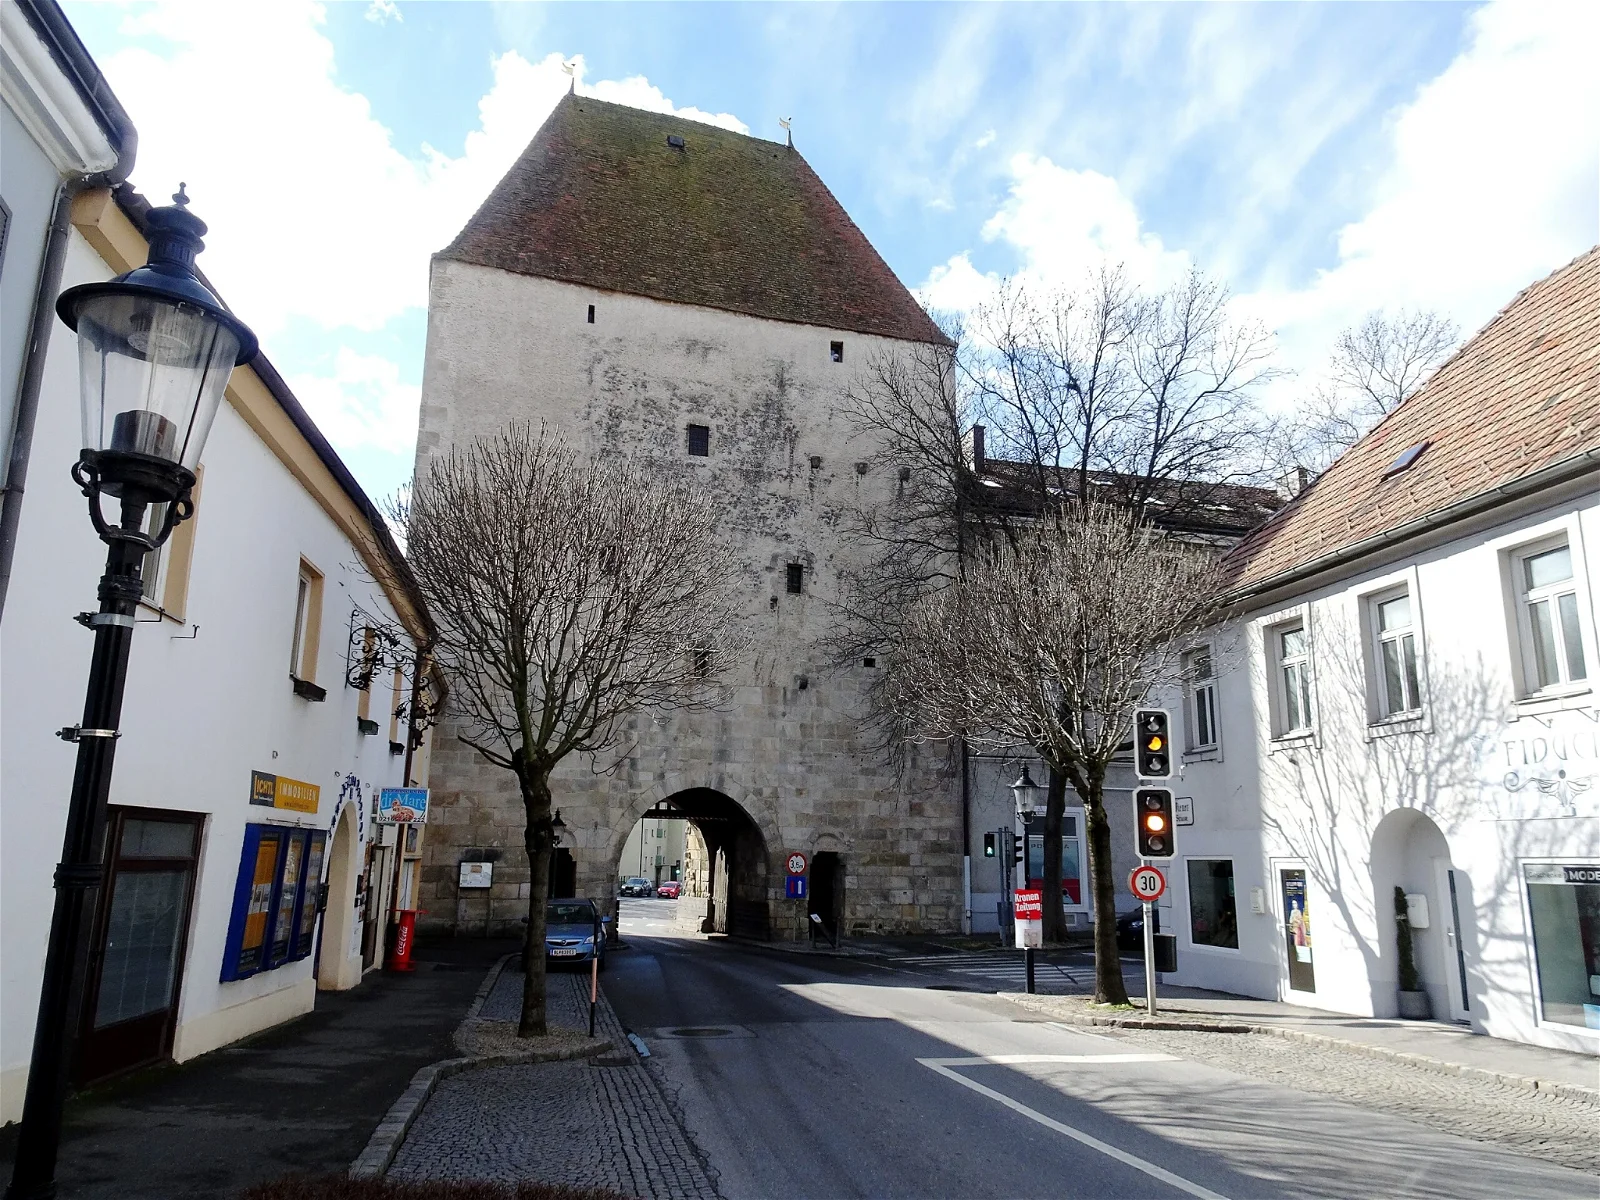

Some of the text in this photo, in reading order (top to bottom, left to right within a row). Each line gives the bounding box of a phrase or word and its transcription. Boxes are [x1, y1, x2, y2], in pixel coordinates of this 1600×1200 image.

[397, 793, 426, 809] Mare
[1140, 875, 1156, 892] 30
[1015, 893, 1039, 902] Kronen
[1016, 902, 1040, 911] Zeitung
